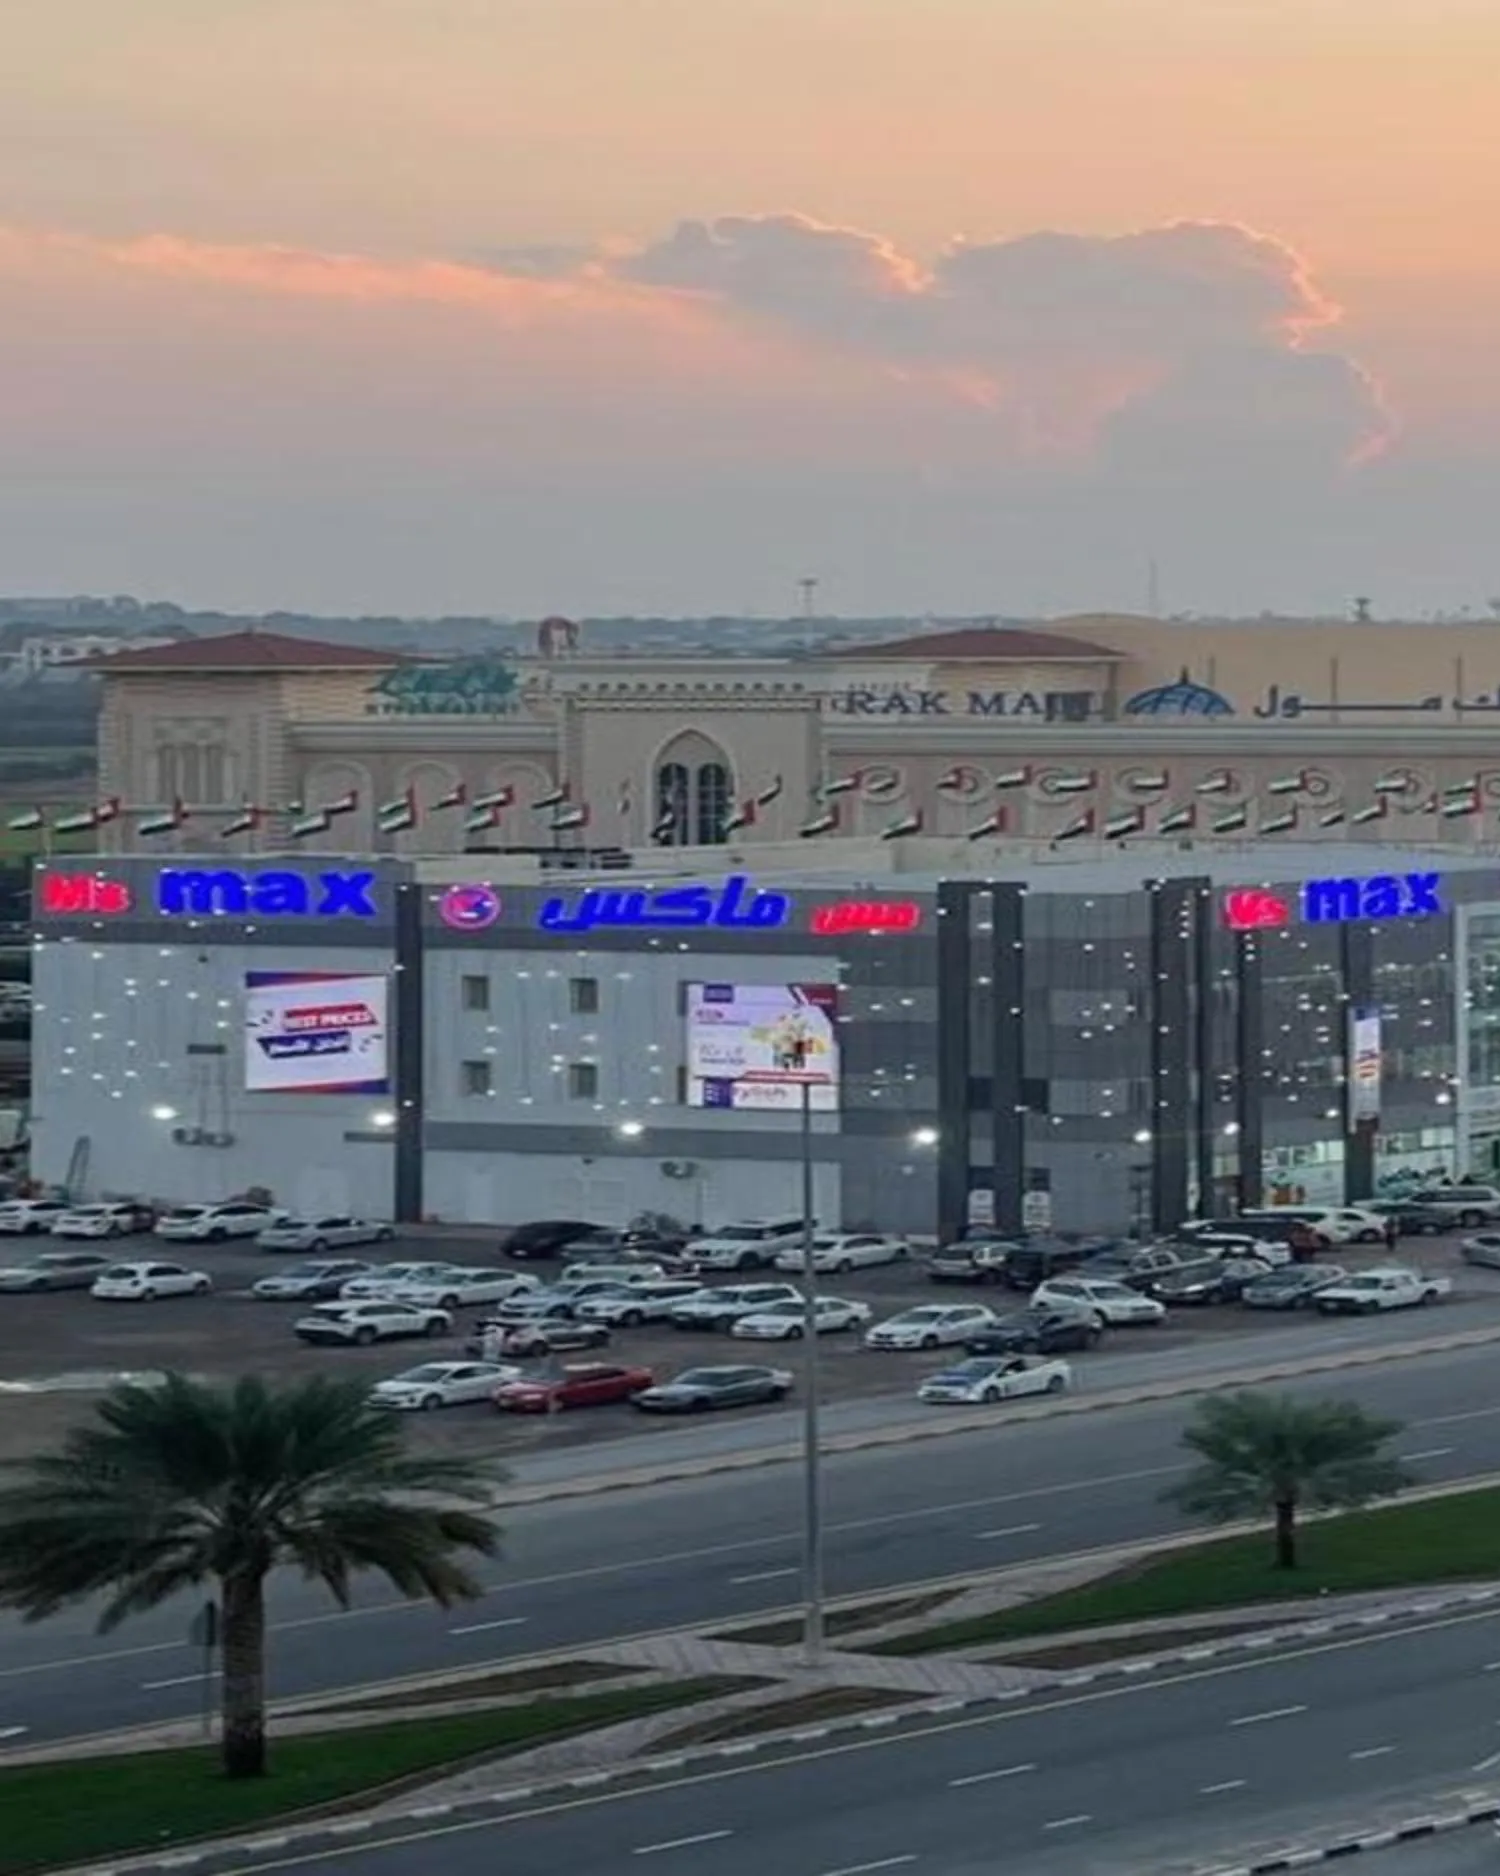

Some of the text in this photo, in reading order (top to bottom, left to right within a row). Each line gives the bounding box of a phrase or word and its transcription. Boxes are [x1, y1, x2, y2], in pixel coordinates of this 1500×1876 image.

[844, 689, 950, 715] RAK
[1252, 684, 1443, 719] مول
[158, 868, 378, 915] max
[539, 874, 788, 933] ماكس
[1303, 871, 1442, 922] max
